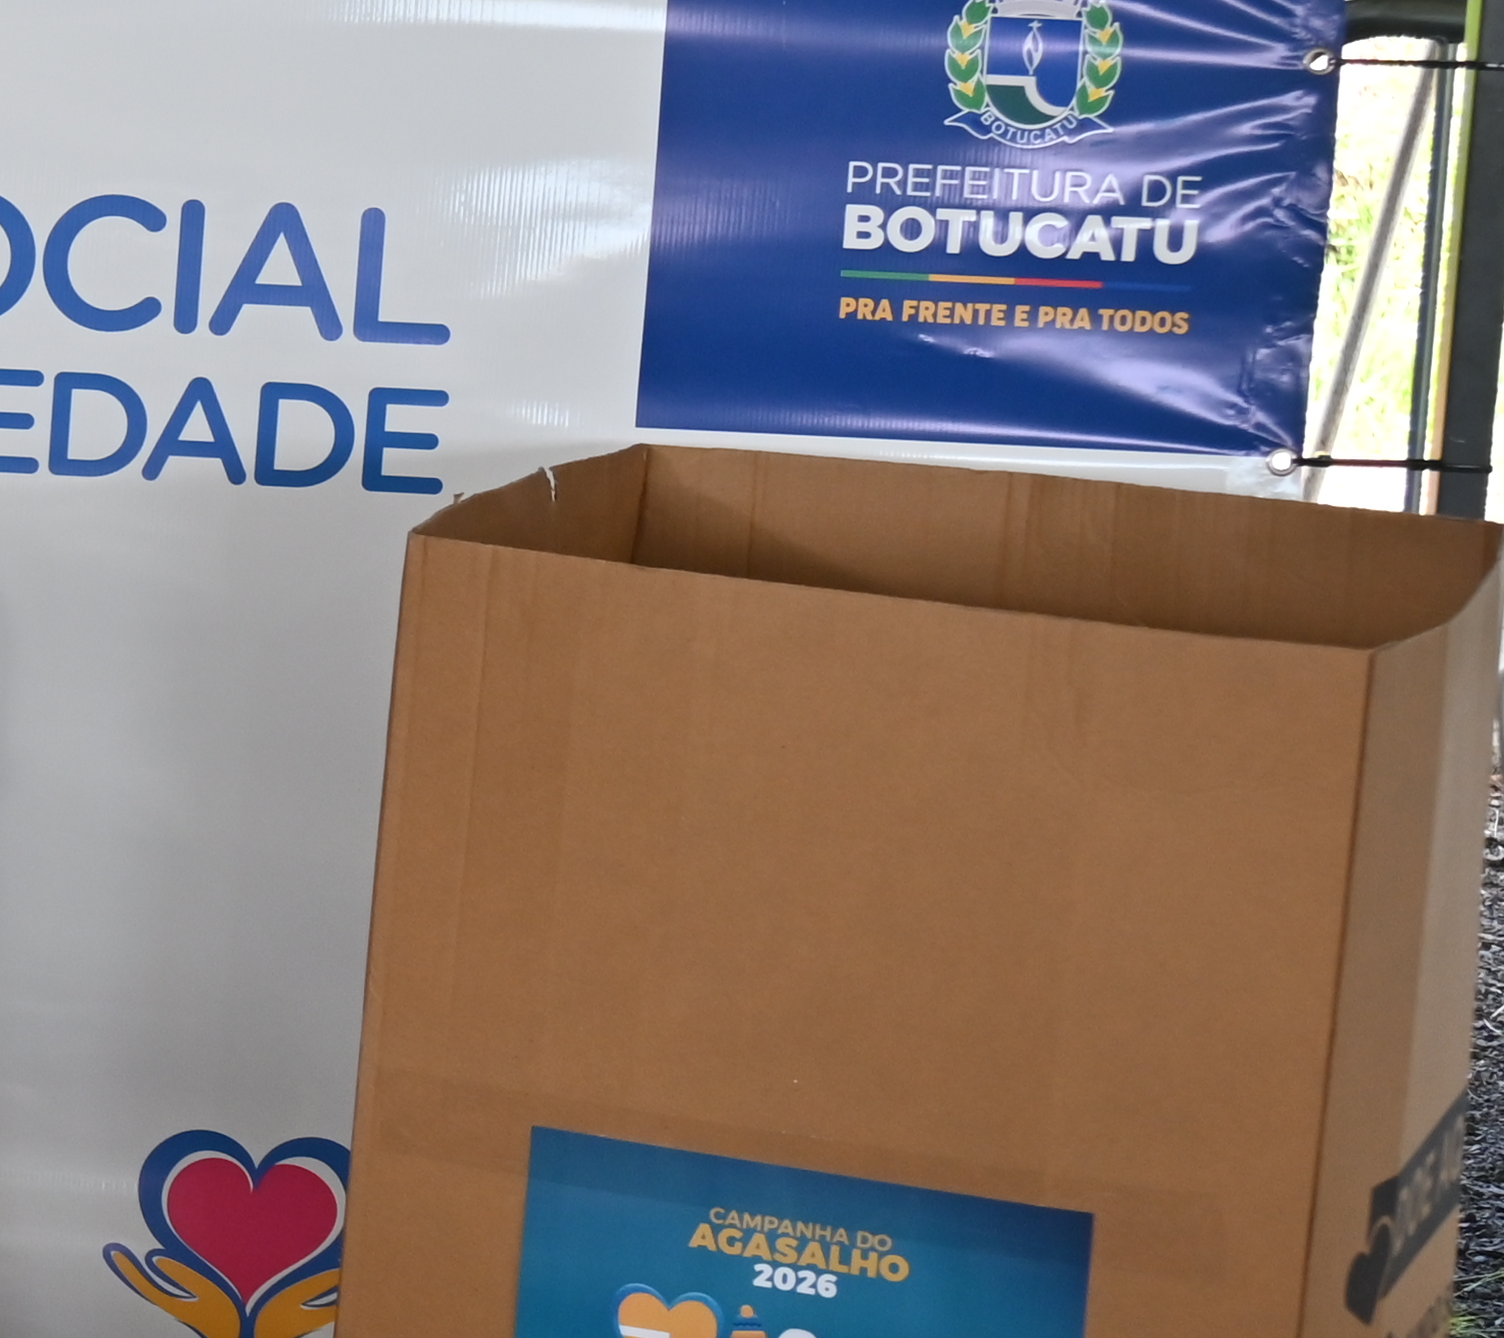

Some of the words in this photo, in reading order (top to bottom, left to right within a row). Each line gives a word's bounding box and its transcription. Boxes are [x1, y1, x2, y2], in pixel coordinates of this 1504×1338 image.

[979, 110, 1077, 145] BOTUCATU
[845, 160, 1126, 206] PREFEITURA
[1141, 174, 1203, 210] DE
[842, 203, 1201, 266] BOTUCATU
[838, 296, 894, 322] PRA
[901, 299, 1008, 327] FRENTE
[1014, 303, 1030, 328] E
[1037, 304, 1093, 331] PRA
[1098, 308, 1190, 335] TODOS
[688, 1221, 911, 1283] AGASALHO
[708, 1206, 850, 1246] CAMPANHA
[855, 1230, 894, 1252] DO
[752, 1263, 839, 1299] 2026
